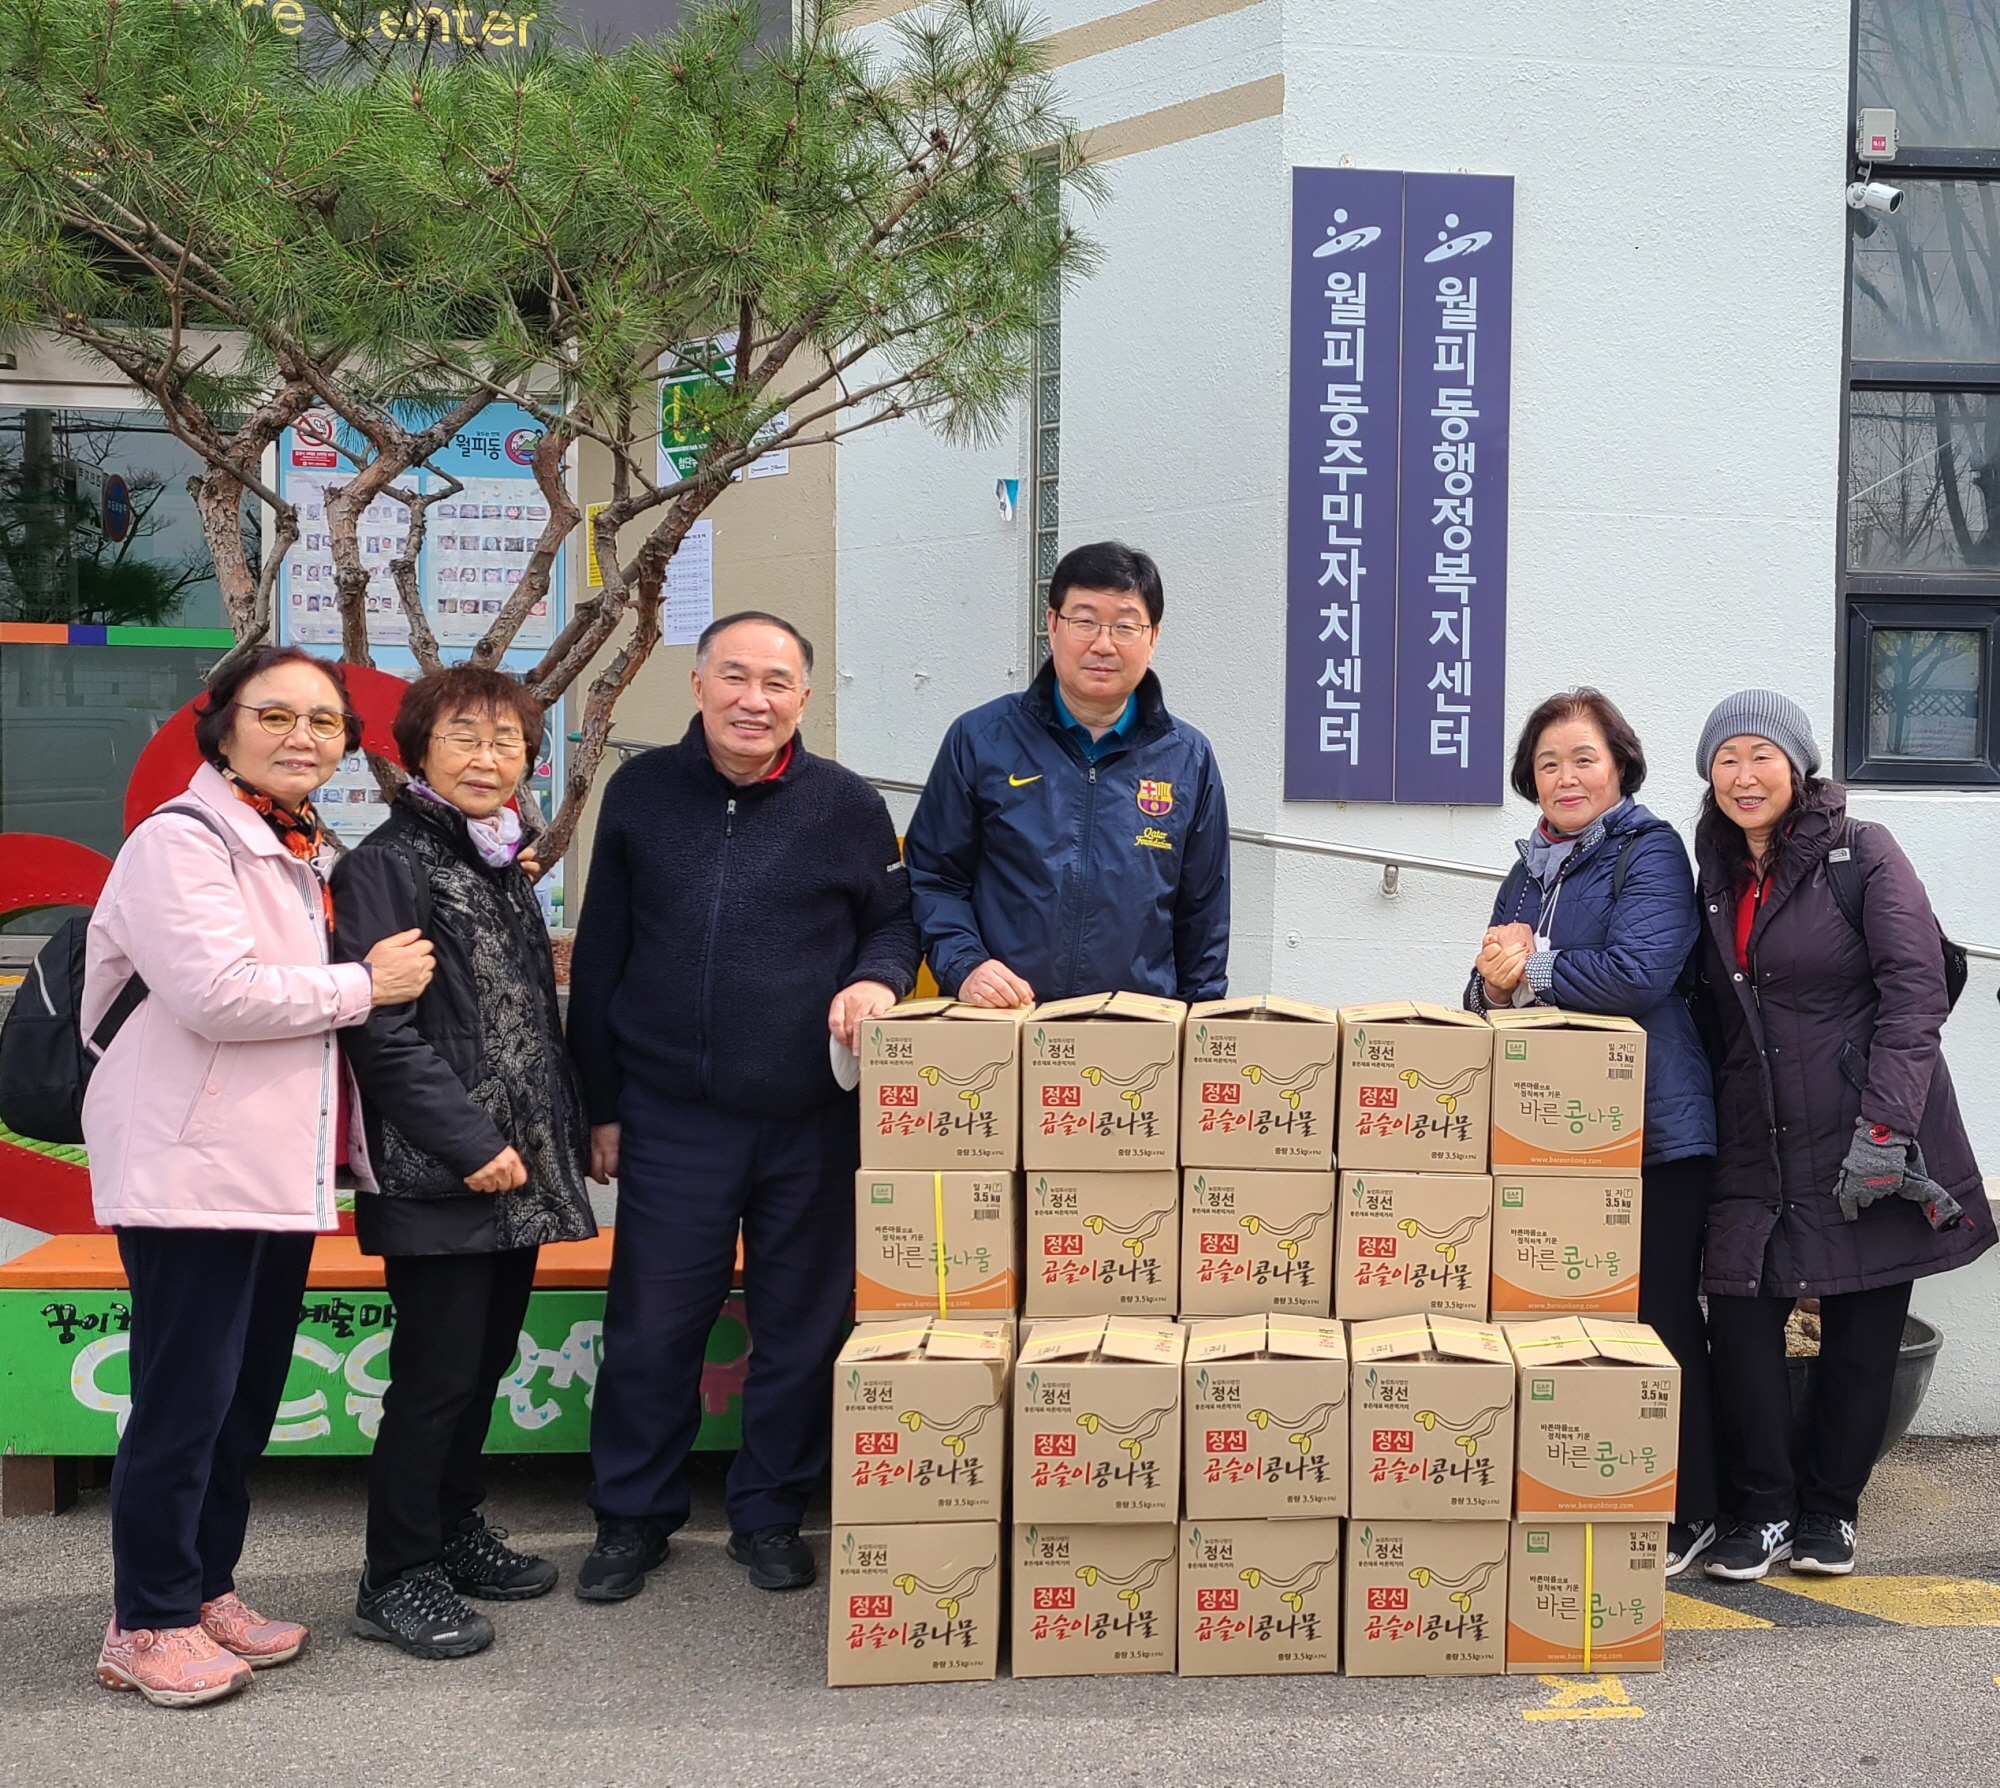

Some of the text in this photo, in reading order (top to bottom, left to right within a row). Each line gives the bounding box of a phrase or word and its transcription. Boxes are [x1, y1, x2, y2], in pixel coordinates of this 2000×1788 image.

[456, 434, 501, 460] 월피동
[1316, 271, 1369, 766] 월피동주민자치센터
[1426, 276, 1480, 769] 월피동행정복지센터
[1144, 827, 1168, 839] Qatar
[885, 1043, 912, 1058] 정선
[1048, 1044, 1075, 1059] 정선
[1210, 1041, 1236, 1056] 정선
[1368, 1045, 1394, 1061] 정선
[1609, 1053, 1634, 1062] 3.5 kg
[882, 1086, 916, 1105] 정선
[1045, 1087, 1078, 1105] 정선
[1204, 1083, 1238, 1103] 정선
[1362, 1087, 1396, 1107] 정선
[877, 1111, 999, 1138] 곱슬이콩나물
[1040, 1111, 1160, 1138] 곱슬이콩나물
[1198, 1108, 1318, 1137] 곱슬이콩나물
[1355, 1111, 1474, 1142] 곱슬이콩나물
[1531, 1156, 1601, 1165] www.bareunkong.com
[973, 1193, 1000, 1202] 3.5 kg
[1050, 1193, 1077, 1208] 정선
[1208, 1192, 1235, 1207] 정선
[1366, 1195, 1393, 1210] 정선
[1606, 1198, 1631, 1208] 3.5 kg
[1047, 1235, 1080, 1254] 정선
[1203, 1234, 1236, 1253] 정선
[1361, 1237, 1394, 1256] 정선
[1042, 1258, 1162, 1286] 곱슬이콩나물
[1196, 1258, 1316, 1287] 곱슬이콩나물
[1354, 1262, 1473, 1291] 곱슬이콩나물
[1528, 1302, 1598, 1310] www.bareunkong.com
[863, 1386, 893, 1403] 정선
[1042, 1389, 1071, 1405] 정선
[1212, 1385, 1240, 1402] 정선
[1380, 1385, 1408, 1402] 정선
[1641, 1391, 1668, 1400] 3.5 kg
[858, 1433, 895, 1454] 정선
[1037, 1435, 1073, 1455] 정선
[1209, 1431, 1244, 1451] 정선
[1375, 1431, 1411, 1451] 정선
[852, 1457, 985, 1489] 곱슬이콩나물
[1031, 1461, 1161, 1490] 곱슬이콩나물
[1203, 1454, 1331, 1486] 곱슬이콩나물
[1369, 1457, 1496, 1486] 곱슬이콩나물
[1041, 1542, 1069, 1558] 정선
[1204, 1544, 1233, 1561] 정선
[1375, 1543, 1403, 1559] 정선
[1630, 1542, 1657, 1552] 3.5 kg
[857, 1550, 887, 1567] 정선
[852, 1596, 890, 1617] 정선
[1036, 1587, 1072, 1608] 정선
[1200, 1589, 1236, 1610] 정선
[1370, 1589, 1406, 1608] 정선
[846, 1619, 979, 1652] 곱슬이콩나물
[1030, 1610, 1159, 1643] 곱슬이콩나물
[1195, 1613, 1322, 1644] 곱슬이콩나물
[1364, 1613, 1490, 1643] 곱슬이콩나물
